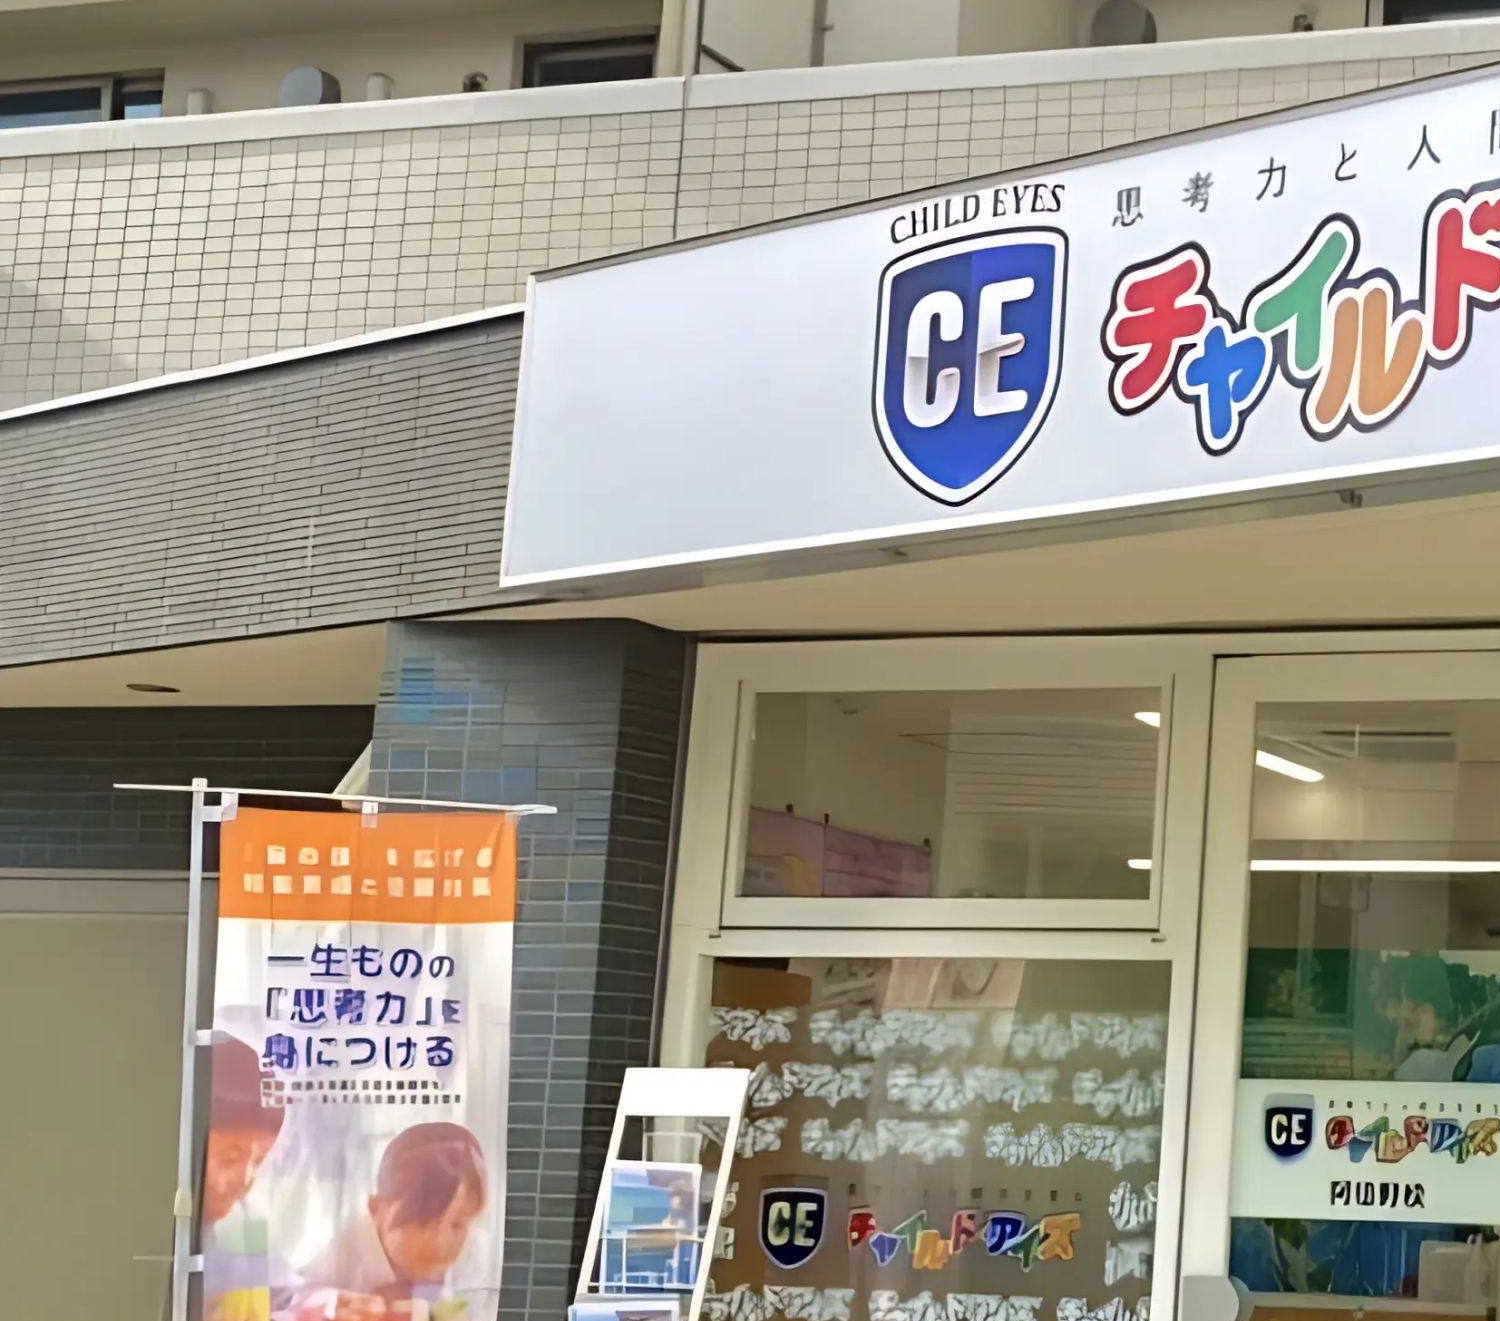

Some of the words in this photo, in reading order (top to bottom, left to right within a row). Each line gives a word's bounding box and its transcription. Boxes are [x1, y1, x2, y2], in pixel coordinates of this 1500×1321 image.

[890, 193, 980, 244] CHILD
[992, 183, 1066, 218] EYES
[906, 277, 1034, 429] CE
[268, 943, 455, 981] 一生ものの
[1271, 1114, 1306, 1146] CE
[768, 1202, 819, 1247] CE
